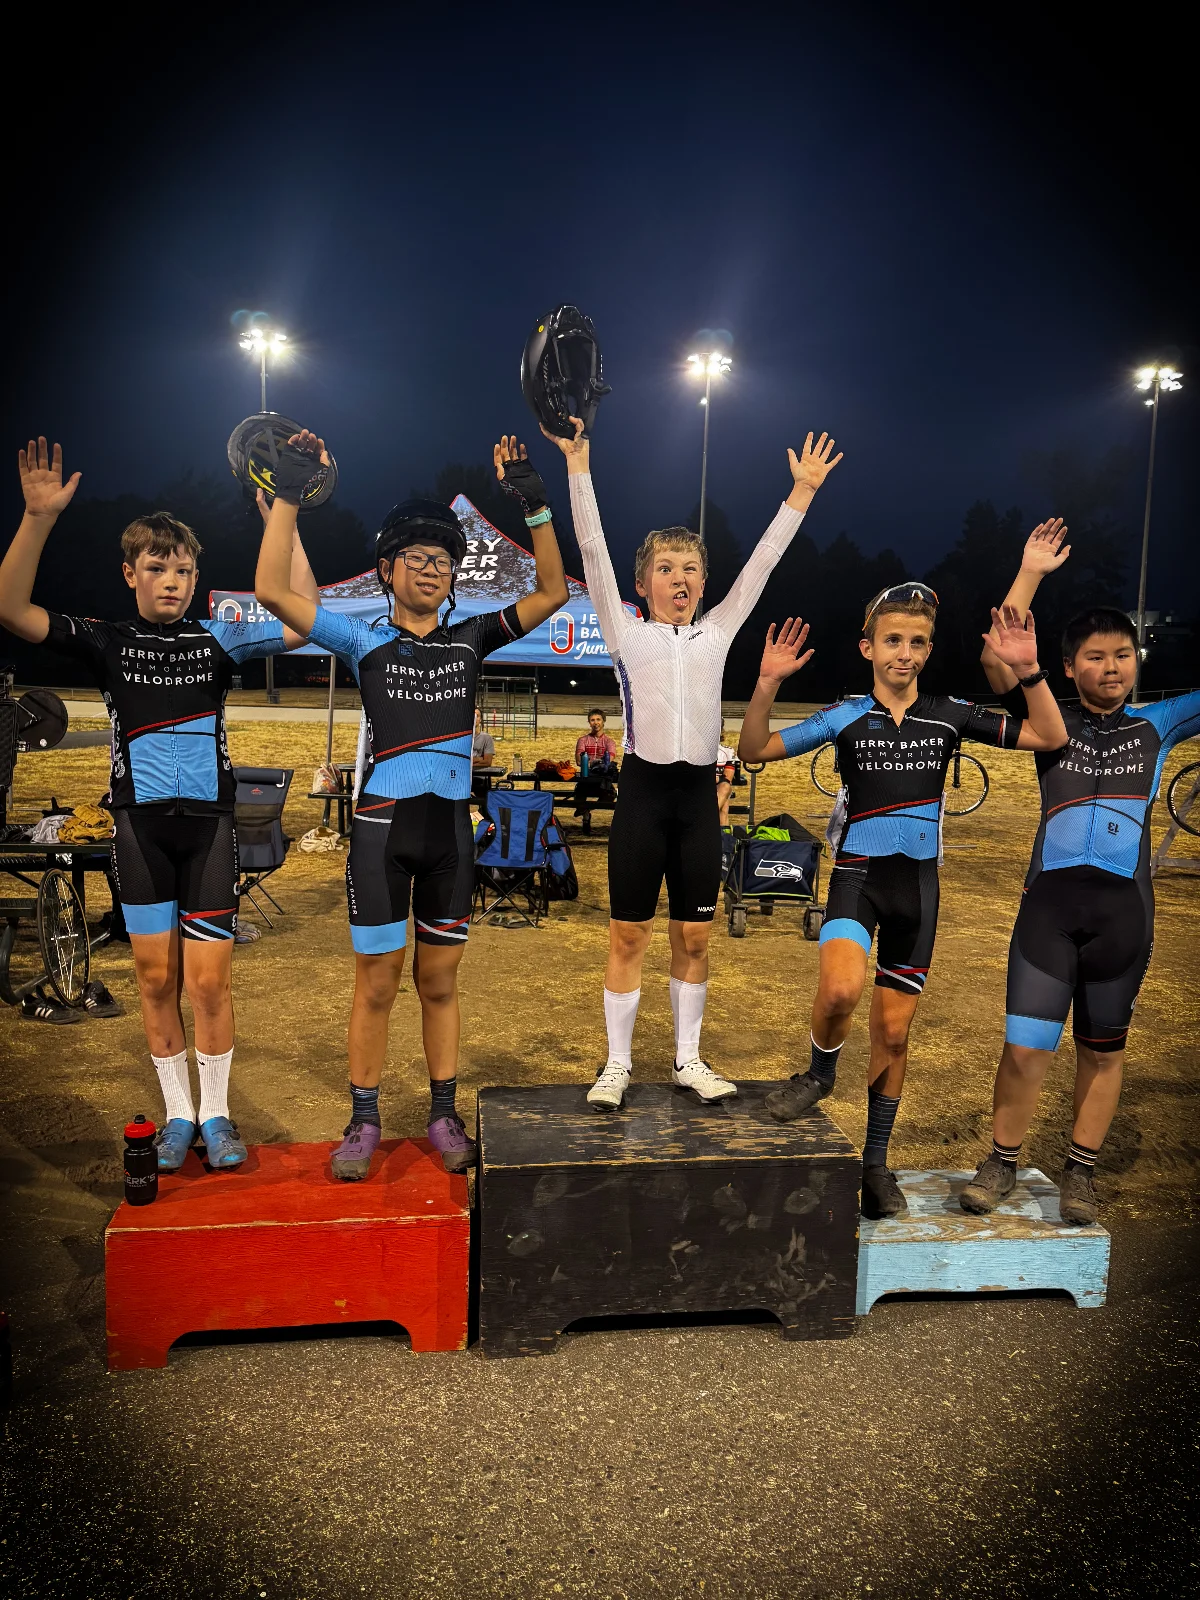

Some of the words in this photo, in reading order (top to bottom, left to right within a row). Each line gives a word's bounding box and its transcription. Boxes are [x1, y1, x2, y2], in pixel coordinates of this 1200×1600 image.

[466, 537, 503, 553] RY
[461, 554, 498, 569] ER
[247, 602, 270, 614] JE
[580, 613, 600, 625] JE
[580, 627, 604, 639] BA
[121, 647, 165, 661] JERRY
[169, 648, 212, 663] BAKER
[121, 660, 213, 672] MEMORIAL
[385, 663, 424, 678] JERRY
[429, 660, 465, 680] BAKER
[122, 672, 213, 686] VELODROME
[386, 676, 466, 690] MEMORIAL
[387, 688, 467, 703] VELODROME
[854, 740, 895, 749] JERRY
[900, 738, 944, 750] BAKER
[1067, 737, 1098, 756] ERRY
[1102, 738, 1142, 758] BAKER
[856, 750, 942, 759] MEMORIAL
[857, 761, 942, 771] VELODROME
[1059, 759, 1144, 776] VELODROME
[125, 1173, 155, 1184] ERK'S
